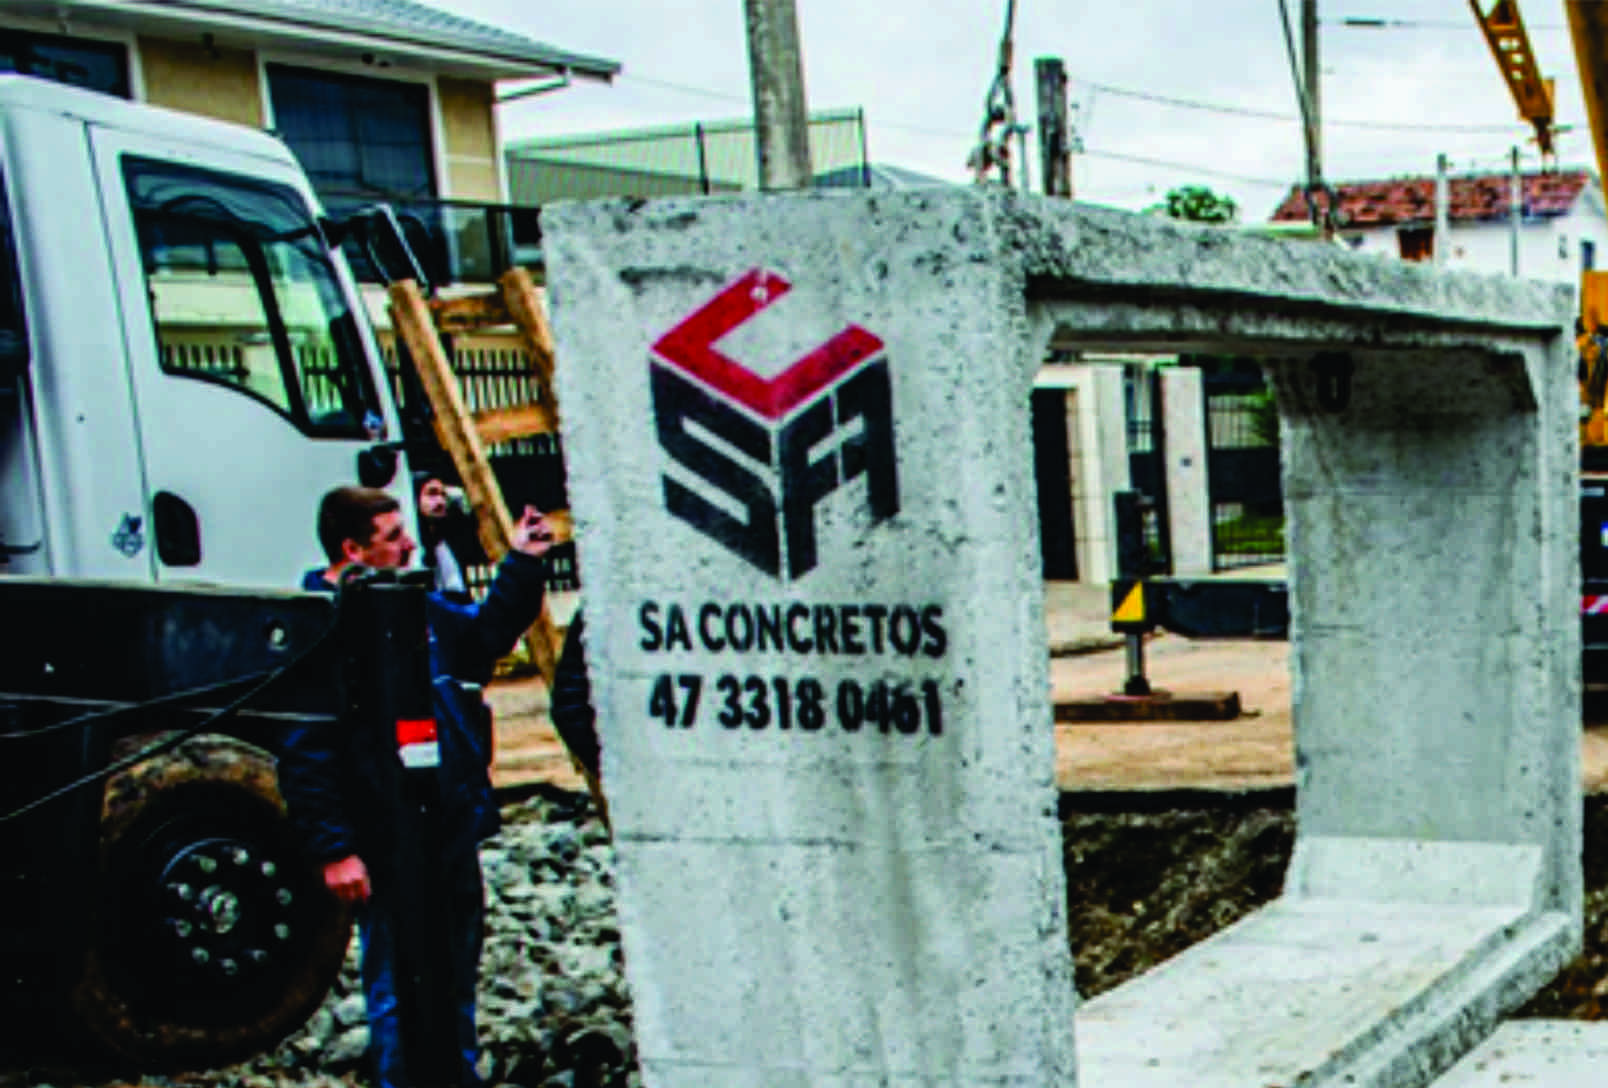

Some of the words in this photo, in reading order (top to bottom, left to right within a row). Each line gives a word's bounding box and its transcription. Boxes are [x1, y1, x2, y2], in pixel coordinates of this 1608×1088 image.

[639, 600, 692, 652] SA
[697, 601, 947, 659] CONCRETOS
[650, 674, 702, 728] 47
[716, 674, 826, 730] 3318
[836, 676, 942, 735] 0461
